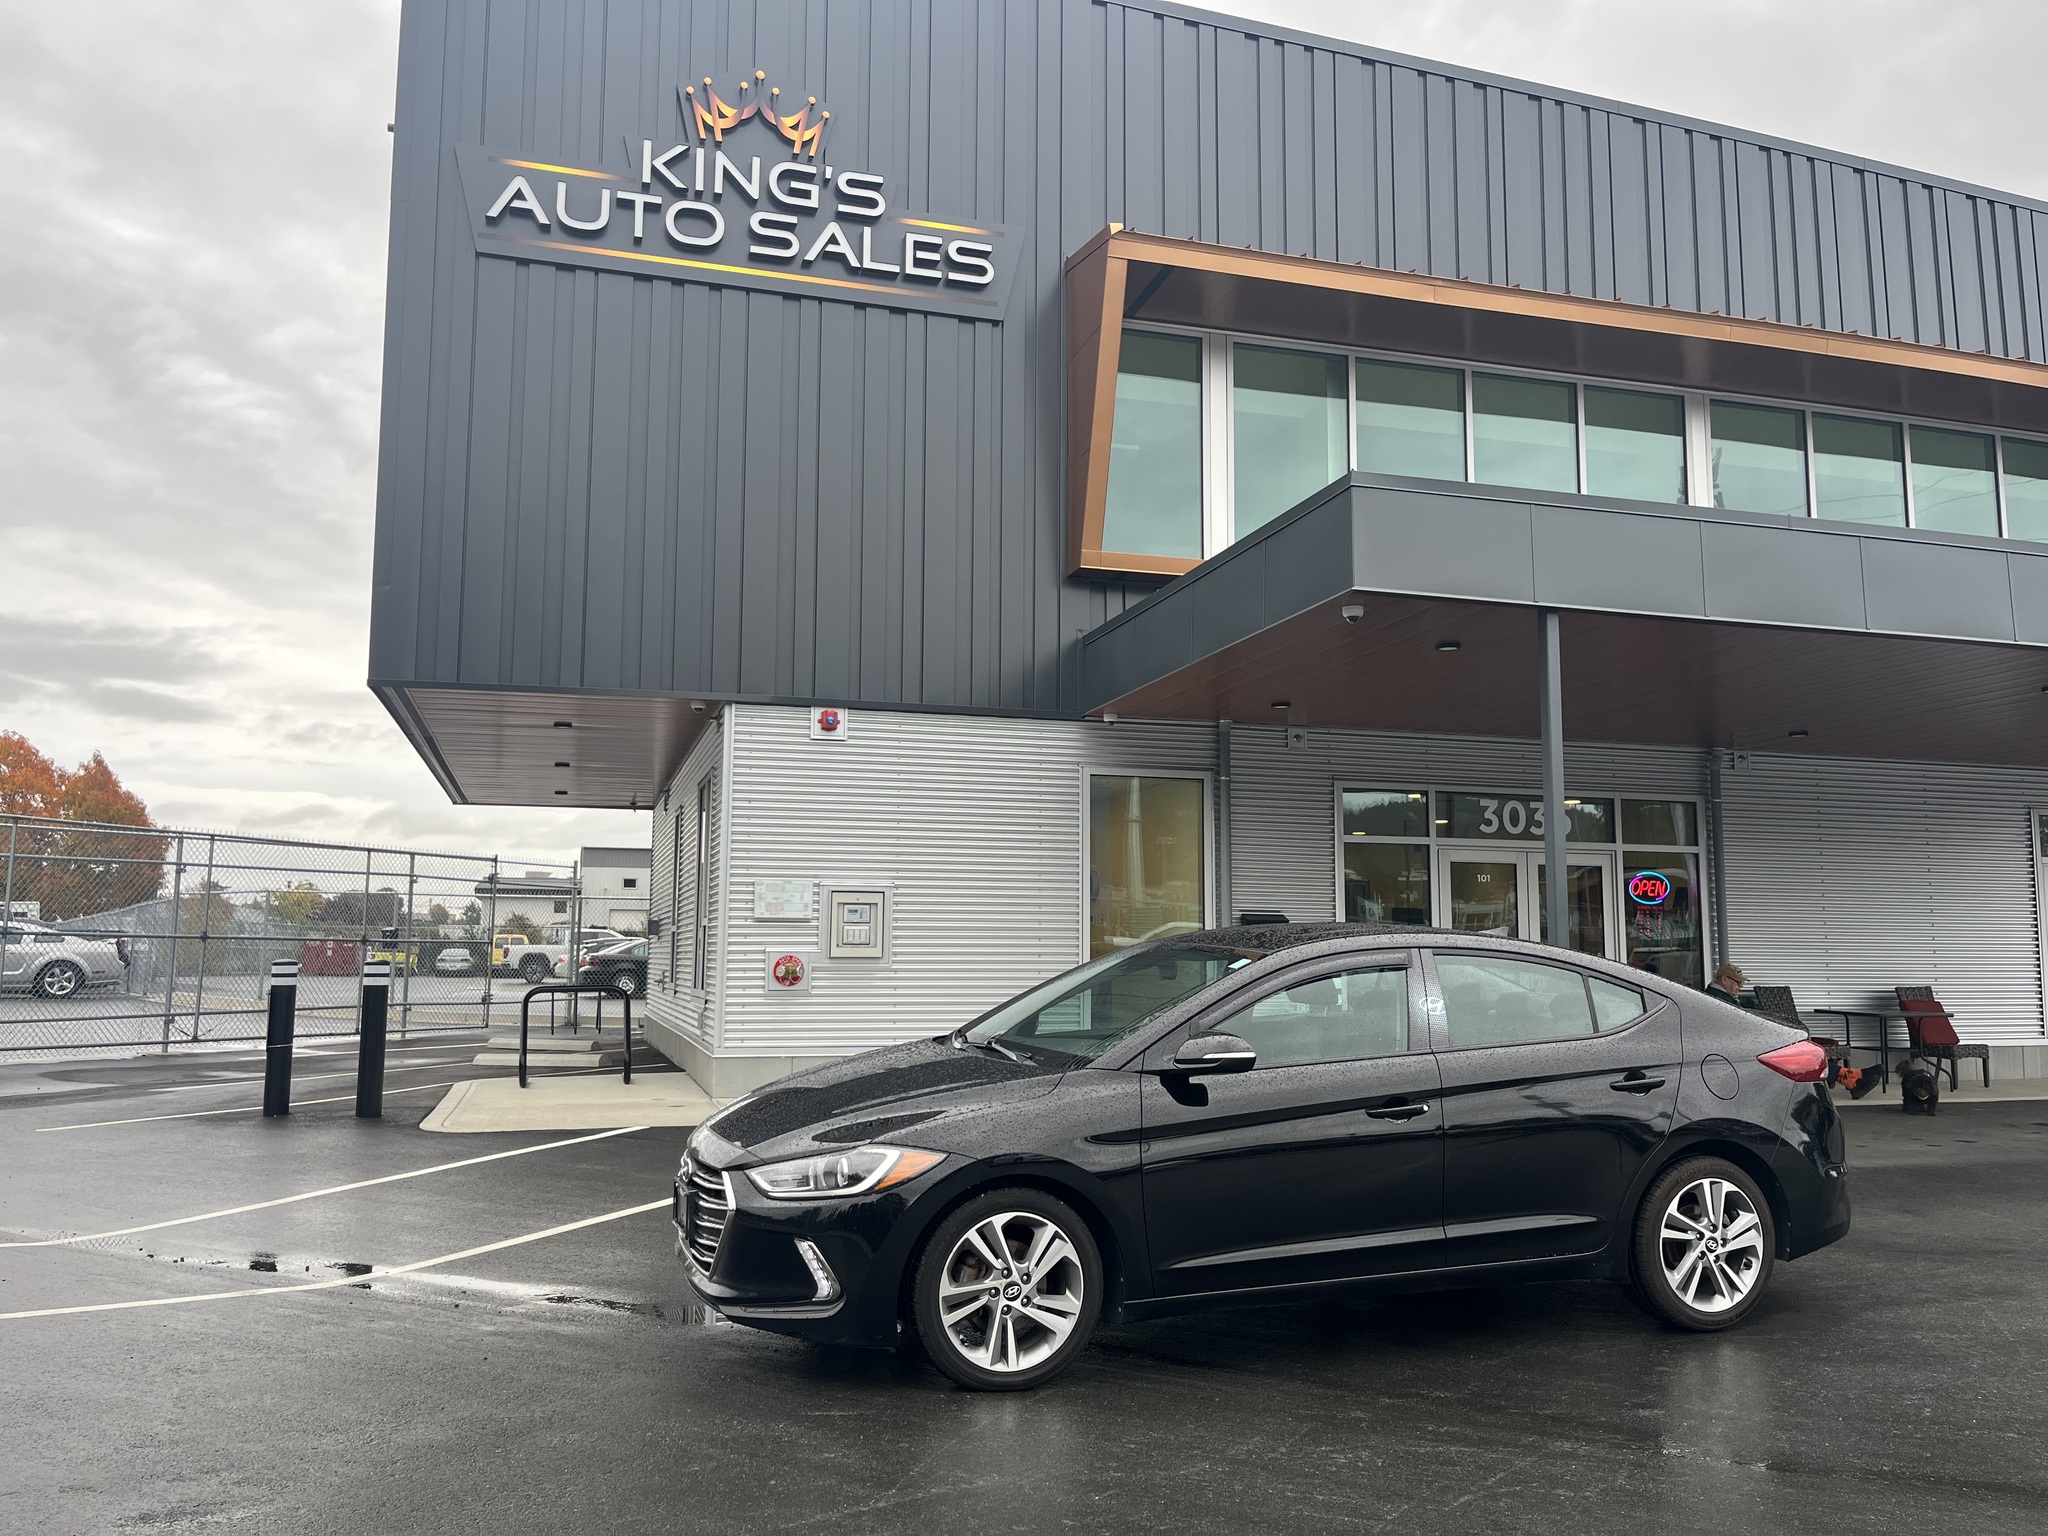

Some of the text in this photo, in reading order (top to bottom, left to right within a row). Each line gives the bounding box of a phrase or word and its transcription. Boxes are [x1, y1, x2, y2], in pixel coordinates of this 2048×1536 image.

[641, 138, 887, 218] KING'S
[485, 175, 996, 286] AUTO SALES
[1477, 874, 1491, 882] 101
[1631, 879, 1666, 897] OPEN
